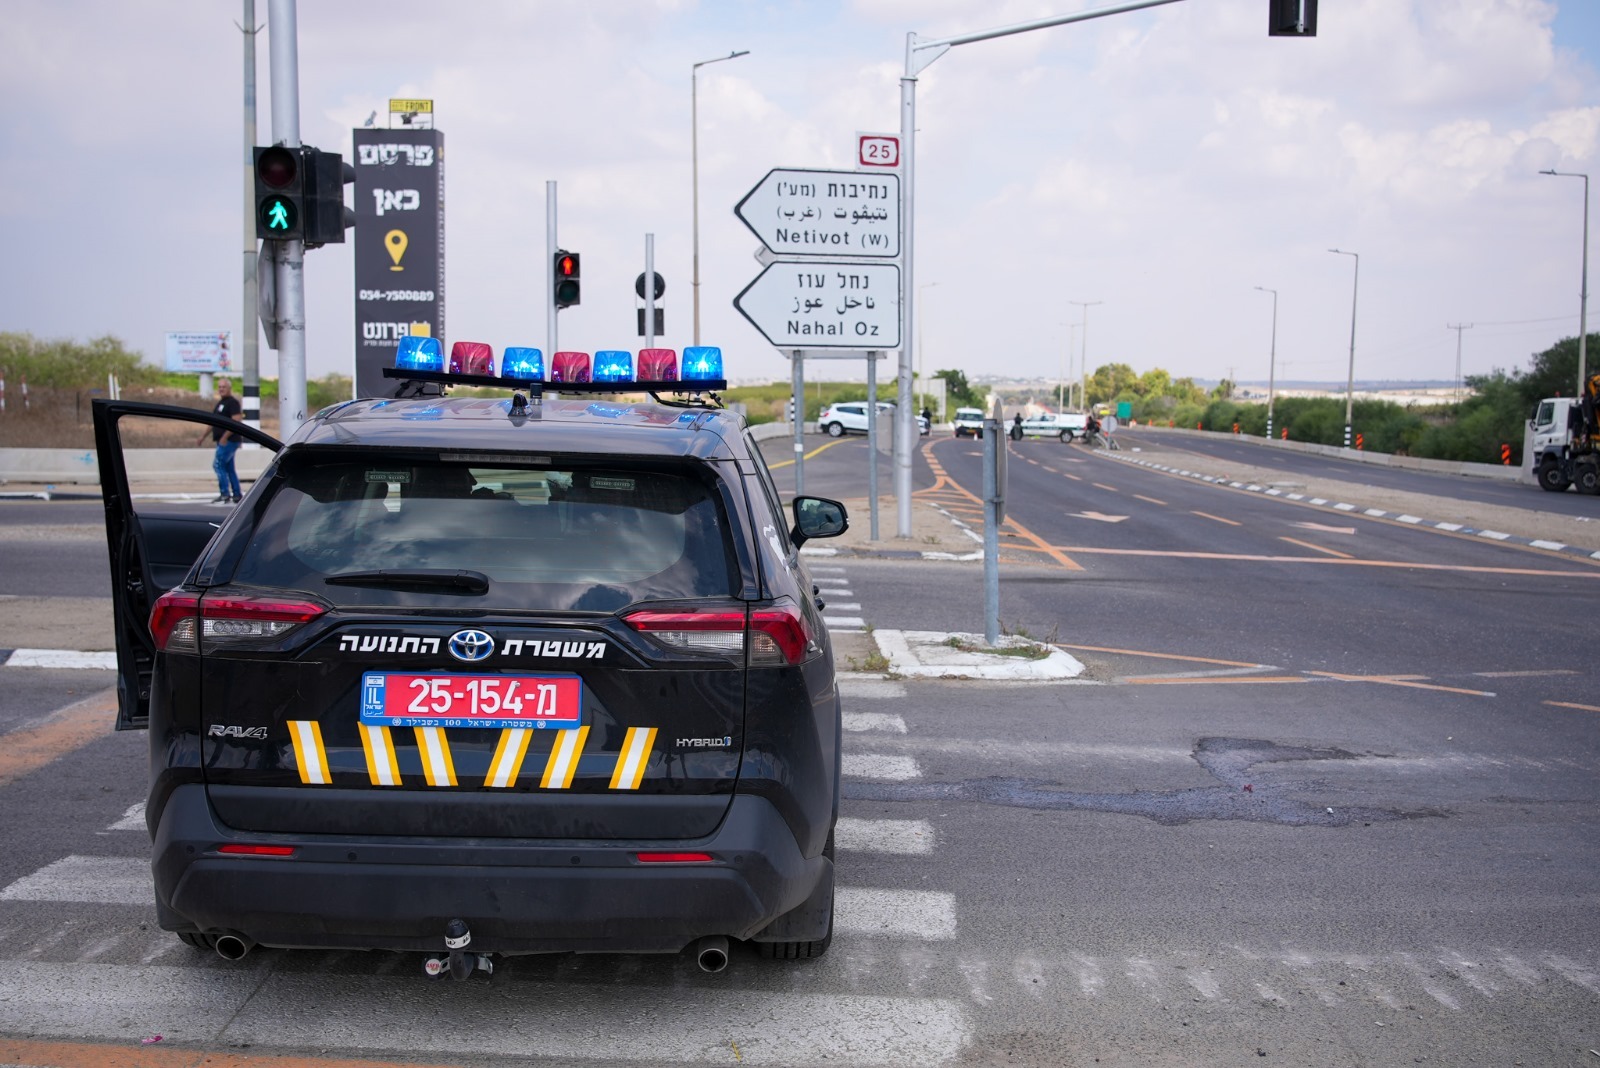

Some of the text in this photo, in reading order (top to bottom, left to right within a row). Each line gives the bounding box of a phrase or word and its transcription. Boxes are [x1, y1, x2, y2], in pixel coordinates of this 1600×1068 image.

[868, 144, 890, 159] 25
[827, 183, 888, 199] נתיבות
[372, 188, 420, 216] כאן
[776, 206, 822, 222] (غرب)
[776, 228, 889, 249] Netivot (W)
[797, 272, 870, 289] נחל עוז
[359, 289, 434, 302] 054-7500889
[791, 296, 824, 314] عوز
[363, 321, 409, 340] פרונט
[787, 320, 879, 336] Nahal Oz
[339, 634, 607, 659] משטרת התנועה
[368, 687, 381, 704] IL
[405, 717, 533, 728] משטרת ישראל 100 בשבילך
[207, 724, 268, 739] RAV4
[676, 738, 723, 747] HYBRID
